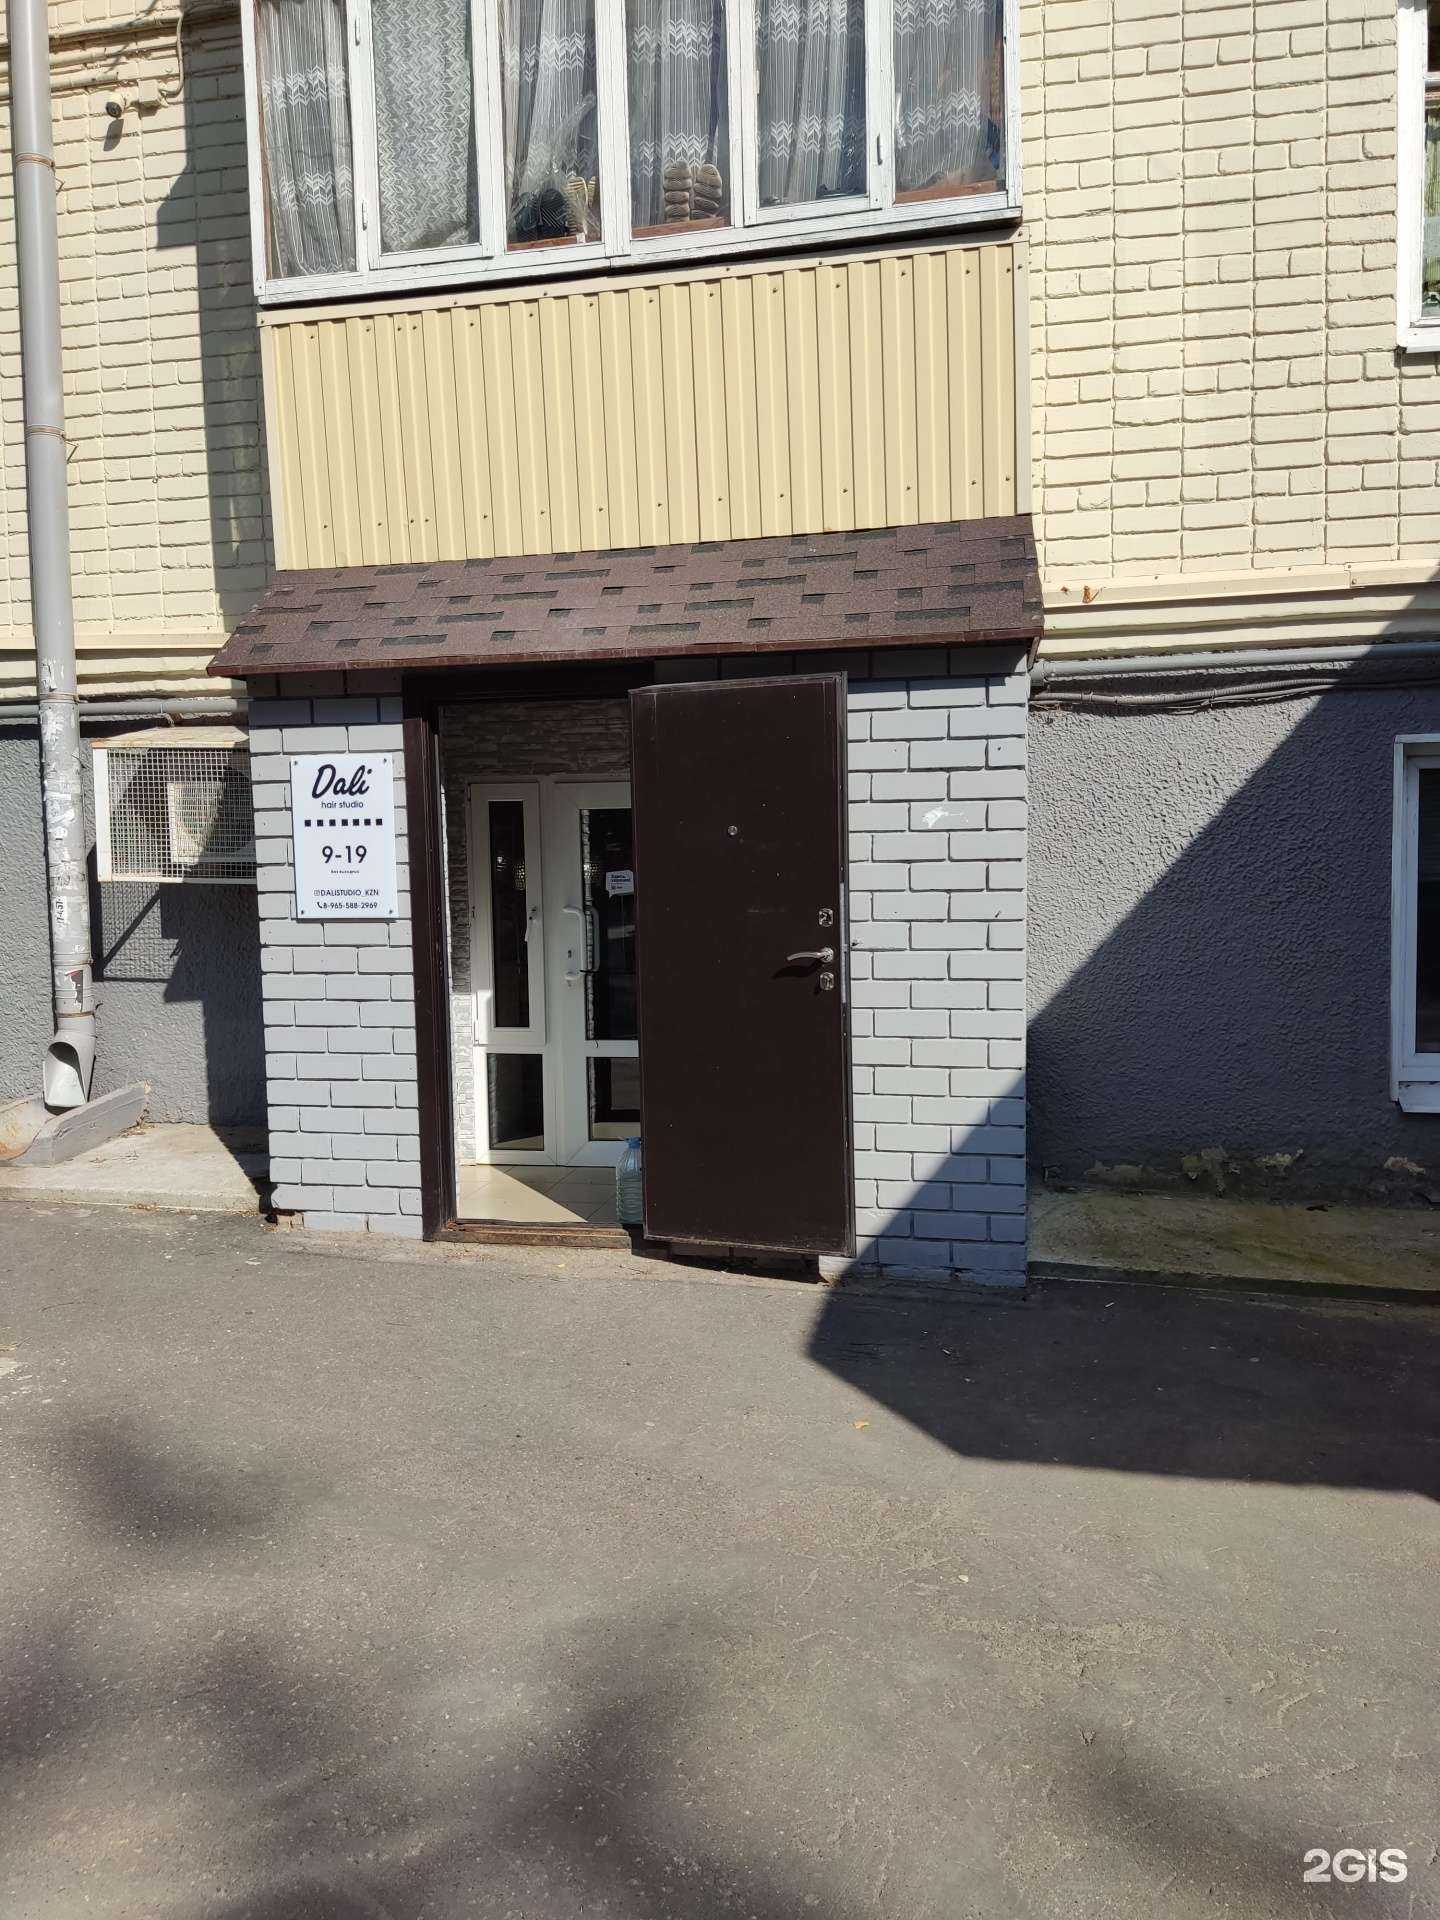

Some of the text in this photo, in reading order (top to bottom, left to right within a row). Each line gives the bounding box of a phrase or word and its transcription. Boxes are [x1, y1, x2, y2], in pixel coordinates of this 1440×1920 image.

[311, 764, 372, 799] Dali
[321, 801, 364, 809] hair studio
[322, 845, 367, 864] 9-19
[323, 901, 378, 909] 8-965-588-2969
